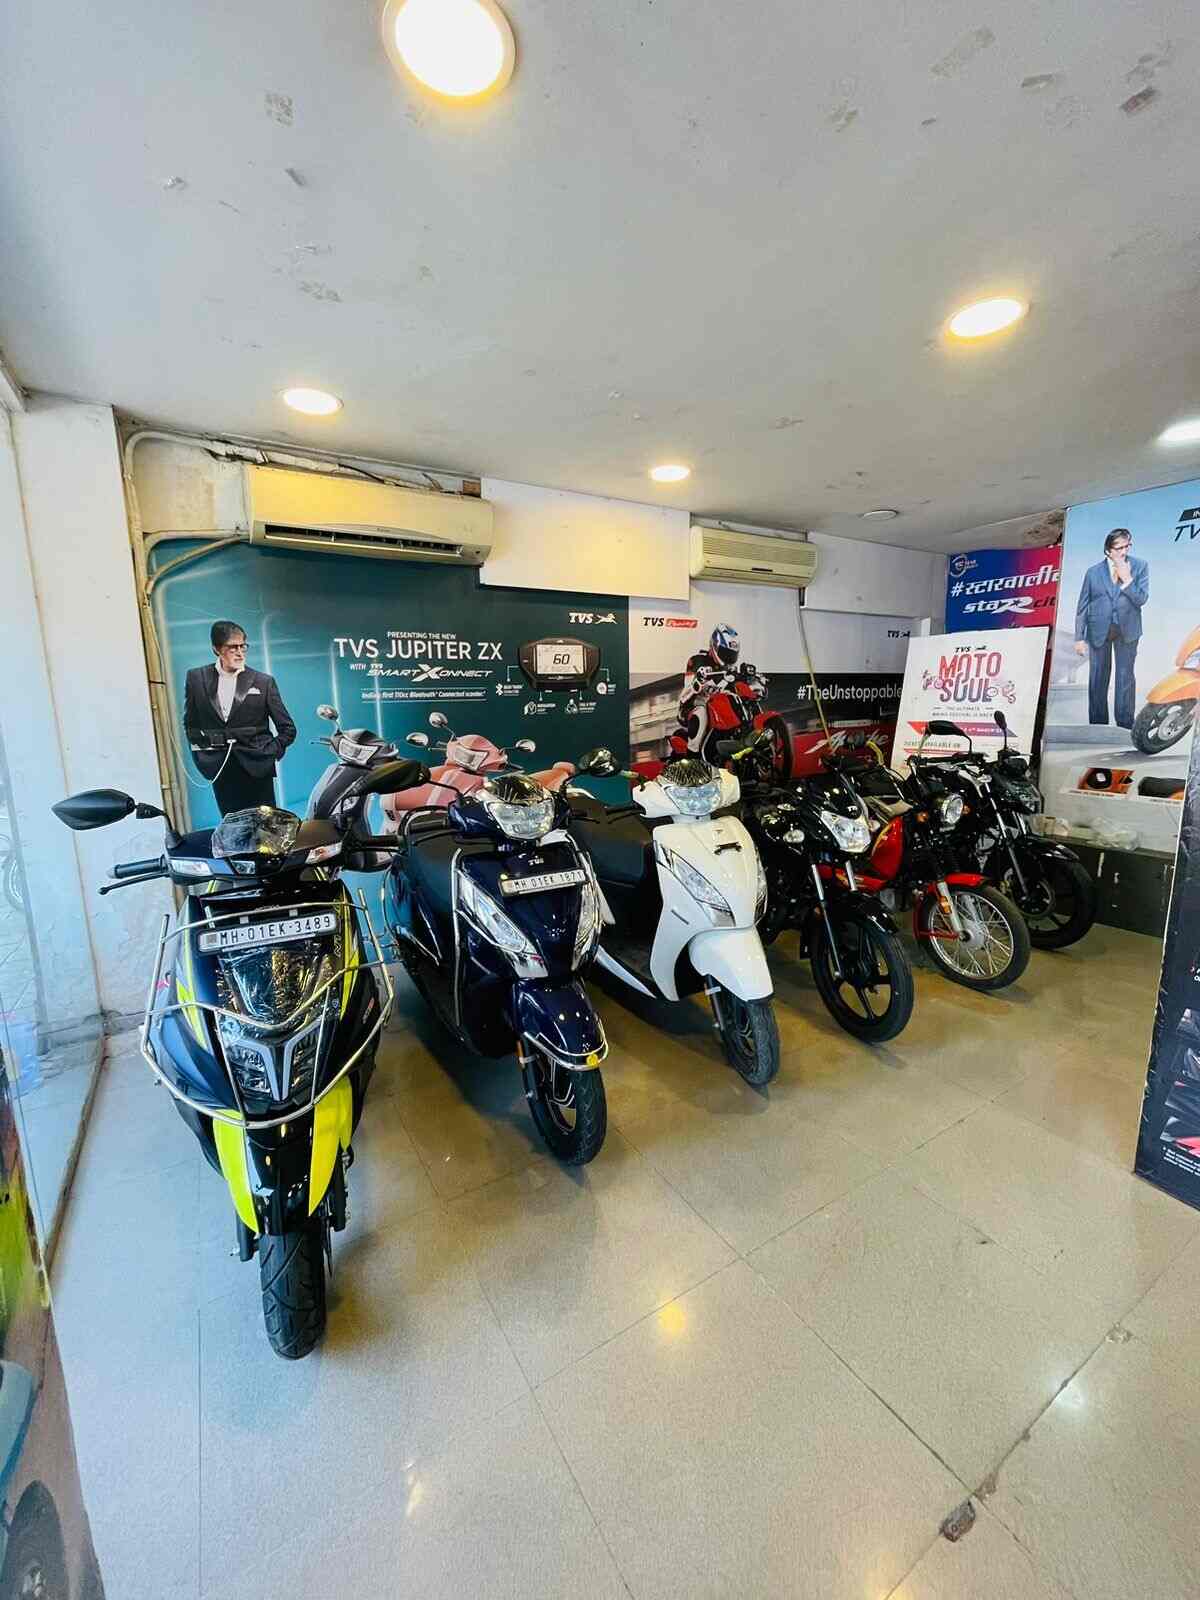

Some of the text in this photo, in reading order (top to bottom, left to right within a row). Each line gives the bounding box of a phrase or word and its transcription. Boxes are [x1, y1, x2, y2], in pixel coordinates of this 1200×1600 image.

[568, 612, 594, 624] TVS
[643, 617, 665, 627] TVS
[387, 631, 428, 639] PRESENTING
[428, 632, 441, 640] THE
[333, 638, 503, 661] TVS JUPITER ZX
[552, 653, 570, 665] 60
[350, 663, 366, 671] WITH
[939, 652, 1002, 682] MOTO
